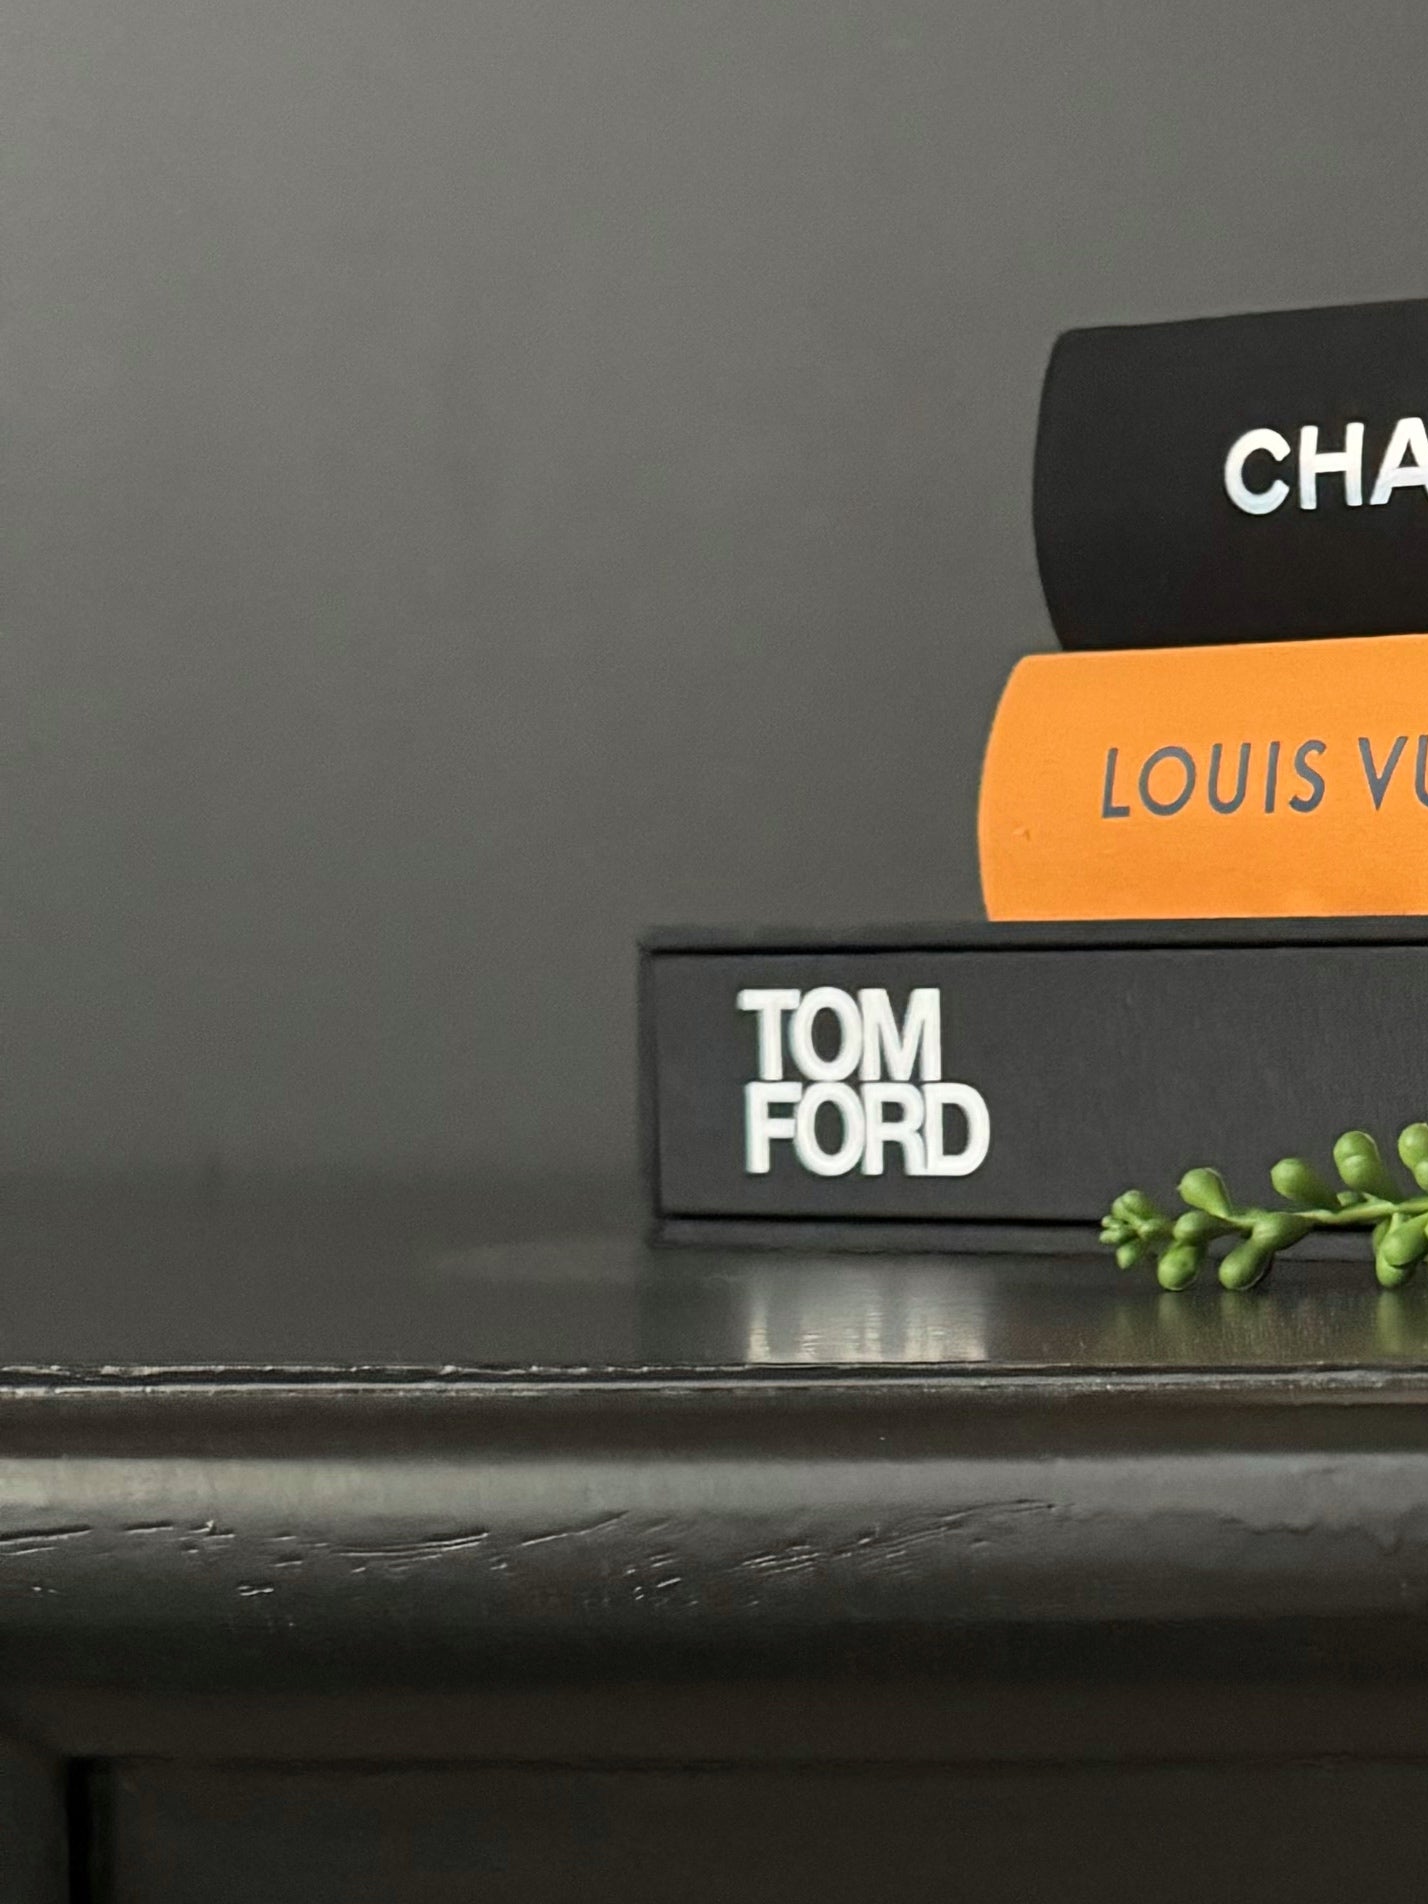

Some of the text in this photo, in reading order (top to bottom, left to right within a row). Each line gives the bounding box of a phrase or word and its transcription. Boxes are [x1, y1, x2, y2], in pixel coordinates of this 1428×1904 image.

[1101, 739, 1327, 819] LOUIS
[736, 986, 942, 1082] TOM
[744, 1081, 991, 1177] FORD
